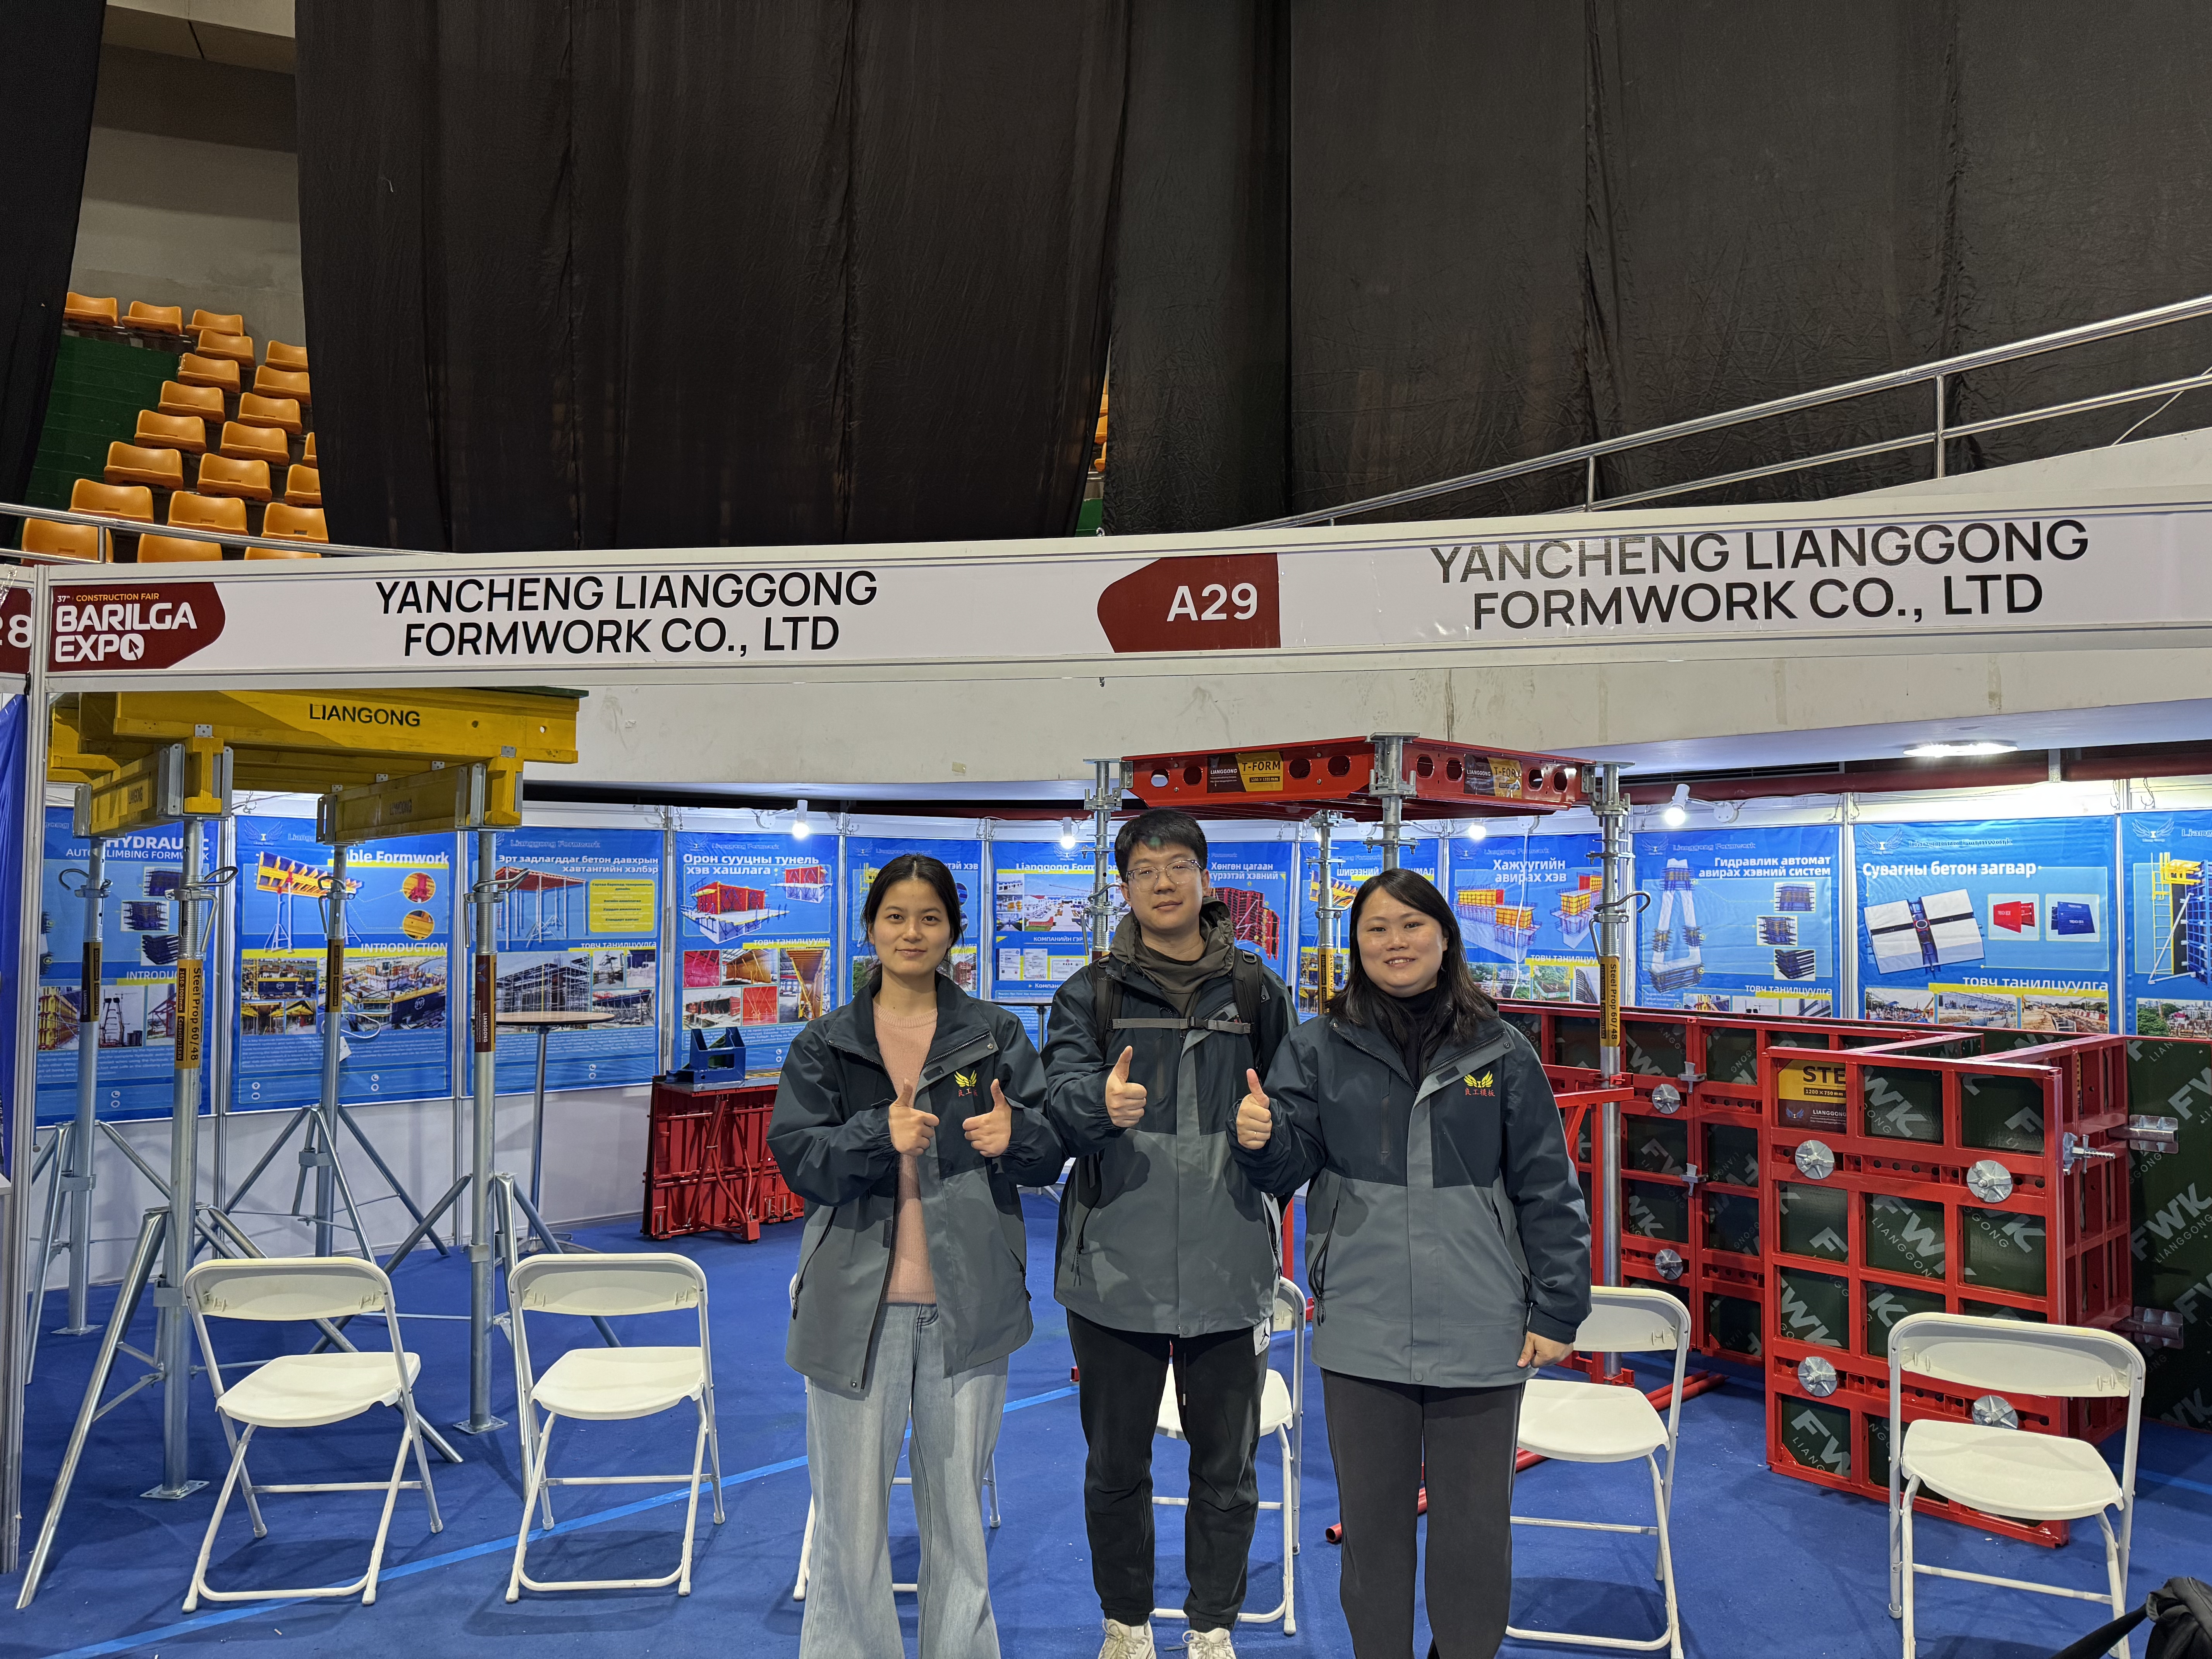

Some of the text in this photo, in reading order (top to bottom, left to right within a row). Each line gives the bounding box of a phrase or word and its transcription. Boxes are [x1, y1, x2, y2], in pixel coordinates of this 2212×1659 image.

[1431, 520, 2088, 583] YANCHENG LIANGGONG
[76, 594, 129, 602] CONSTRUCTION
[376, 570, 878, 614] YANCHENG LIANGGONG
[1167, 583, 1258, 622] A29
[1474, 574, 2042, 630] FORMWORK CO., LTD
[56, 602, 197, 632] BARILGA
[0, 614, 31, 648] 8
[404, 616, 840, 658] FORMWORK CO., LTD
[55, 634, 144, 662] EXPO
[309, 704, 420, 726] LIANGONG
[1242, 761, 1280, 771] T-FORM
[376, 851, 449, 864] Formwork
[683, 854, 819, 866] Орон сууцны тунель
[1714, 856, 1831, 868] Гидравлик автомат
[563, 865, 658, 874] хавтангийн хэлбэр
[686, 866, 771, 875] хэв хашлага
[1016, 862, 1069, 872] Lianggong
[1211, 862, 1273, 872] Хөнгөн цагаан
[1698, 866, 1831, 879] авирах хэвний систем
[1863, 861, 2036, 879] Сувагны бетон загвар
[1247, 871, 1278, 880] хэвний
[1545, 873, 1566, 882] хэв
[361, 943, 448, 953] INTRODUCTION
[193, 968, 201, 995] Steel
[1963, 977, 2109, 993] товч танилцуулга
[1769, 986, 1832, 996] танилцуулга
[190, 999, 200, 1024] Prop
[1803, 1066, 1846, 1085] STE
